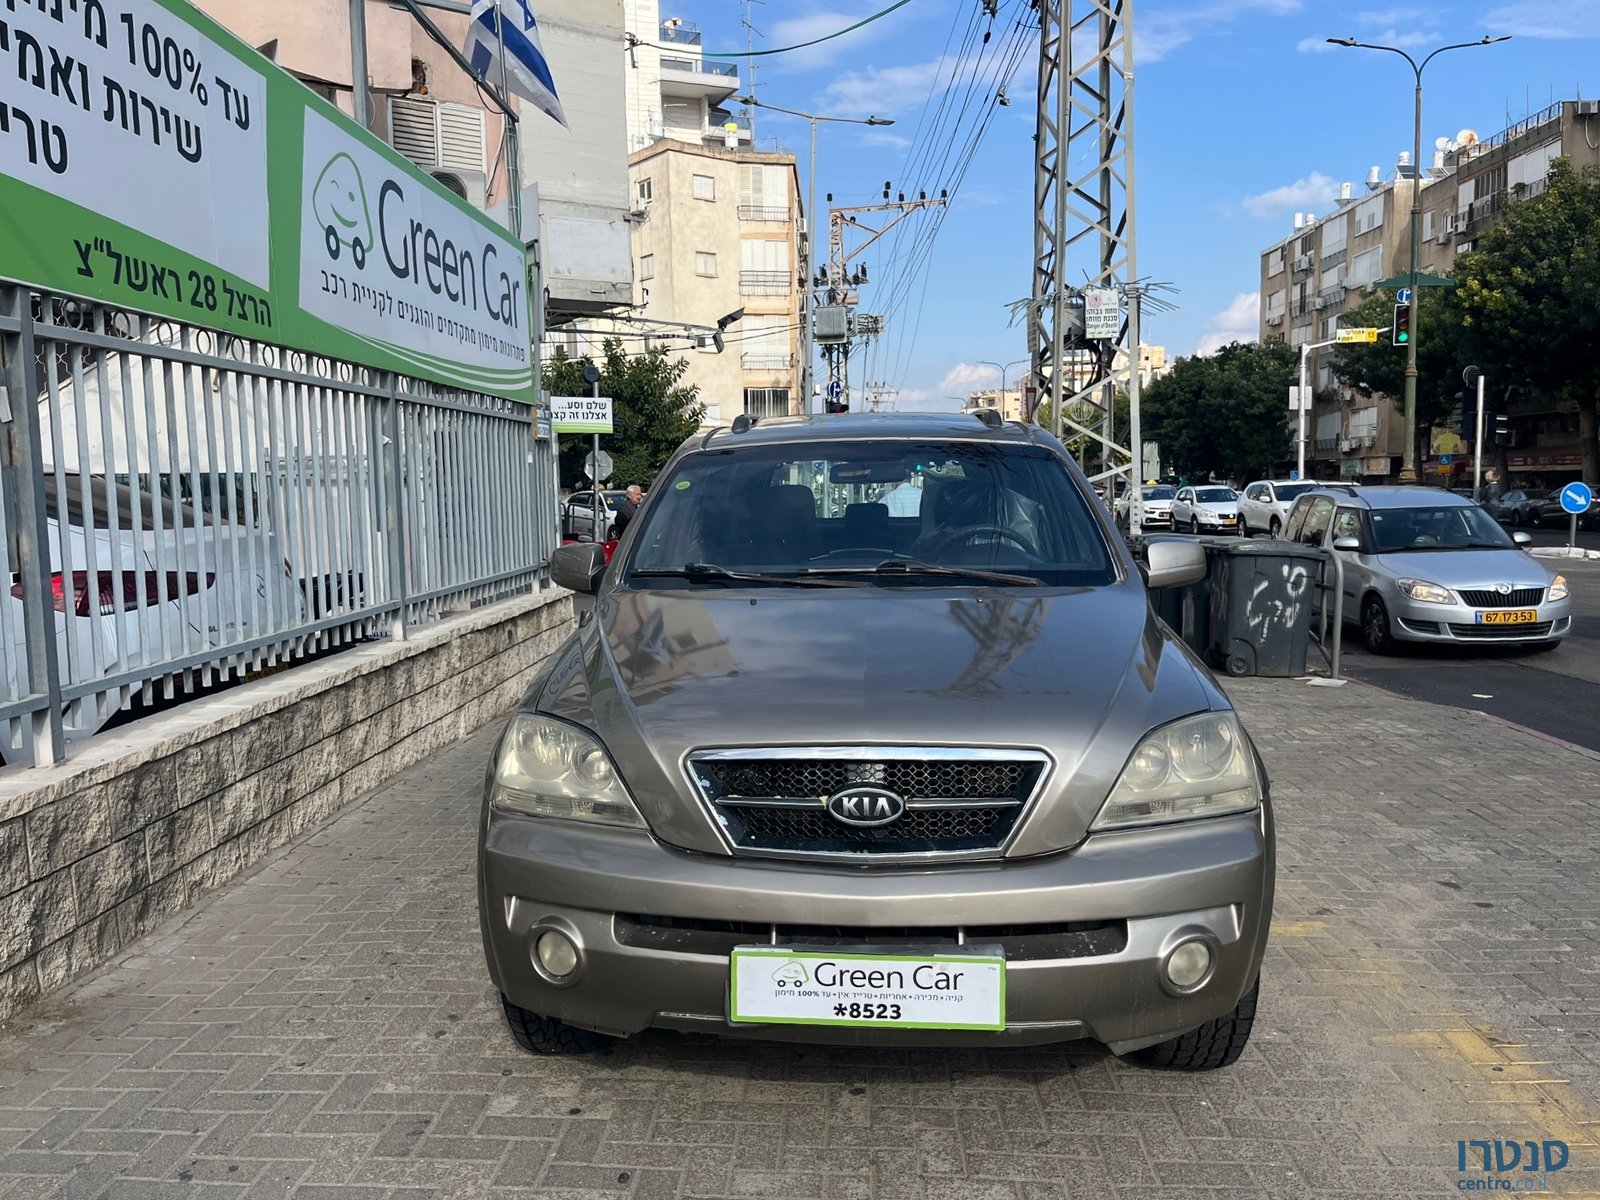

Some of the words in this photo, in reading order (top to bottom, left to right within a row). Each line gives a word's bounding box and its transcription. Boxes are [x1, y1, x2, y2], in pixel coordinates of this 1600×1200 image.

[120, 13, 208, 106] 100%
[215, 76, 249, 131] עד
[103, 76, 201, 163] שירות
[378, 179, 477, 311] Green
[482, 243, 520, 329] Car
[188, 270, 217, 312] 28
[321, 270, 347, 298] רכב
[222, 279, 272, 327] הרצל
[352, 282, 393, 317] לקניית
[398, 300, 434, 330] והוגנים
[437, 316, 476, 345] מתקדמים
[478, 331, 498, 353] מימון
[499, 340, 525, 362] פתרונות
[569, 411, 580, 419] זה
[581, 411, 607, 420] אצלנו
[586, 401, 607, 410] שלם
[842, 797, 892, 816] KIA
[814, 962, 904, 989] Green
[912, 965, 964, 991] Car
[774, 989, 795, 998] מימון
[821, 990, 831, 998] עד
[837, 991, 850, 1000] אין
[879, 992, 907, 1000] אחריות
[914, 993, 939, 1001] מכירה
[945, 994, 963, 1002] קניה
